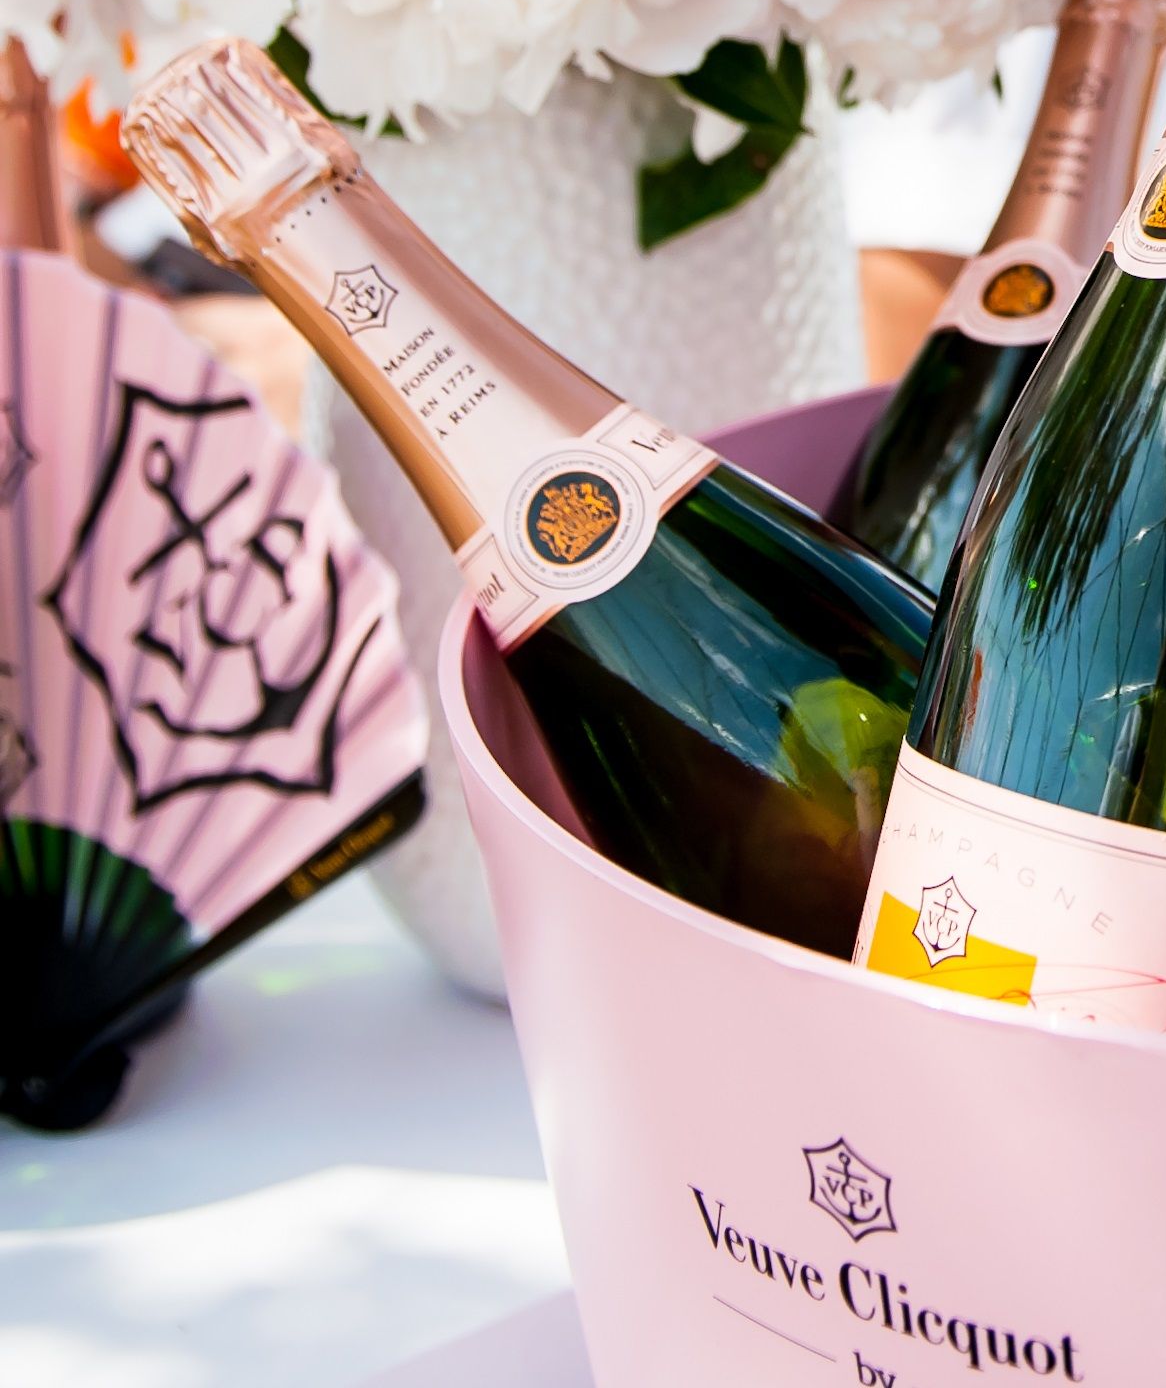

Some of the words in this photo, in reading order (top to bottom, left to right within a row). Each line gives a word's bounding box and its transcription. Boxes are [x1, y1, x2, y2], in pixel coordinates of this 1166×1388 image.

[344, 285, 376, 315] VCP
[382, 325, 436, 377] MAISON
[400, 345, 456, 397] FONDÉE
[419, 397, 440, 418] EN
[440, 364, 476, 396] 1772
[448, 380, 497, 426] REIMS
[929, 910, 958, 936] VCP
[822, 1175, 874, 1209] VCP
[687, 1183, 826, 1302] Veuve
[839, 1261, 1086, 1384] Clicquot
